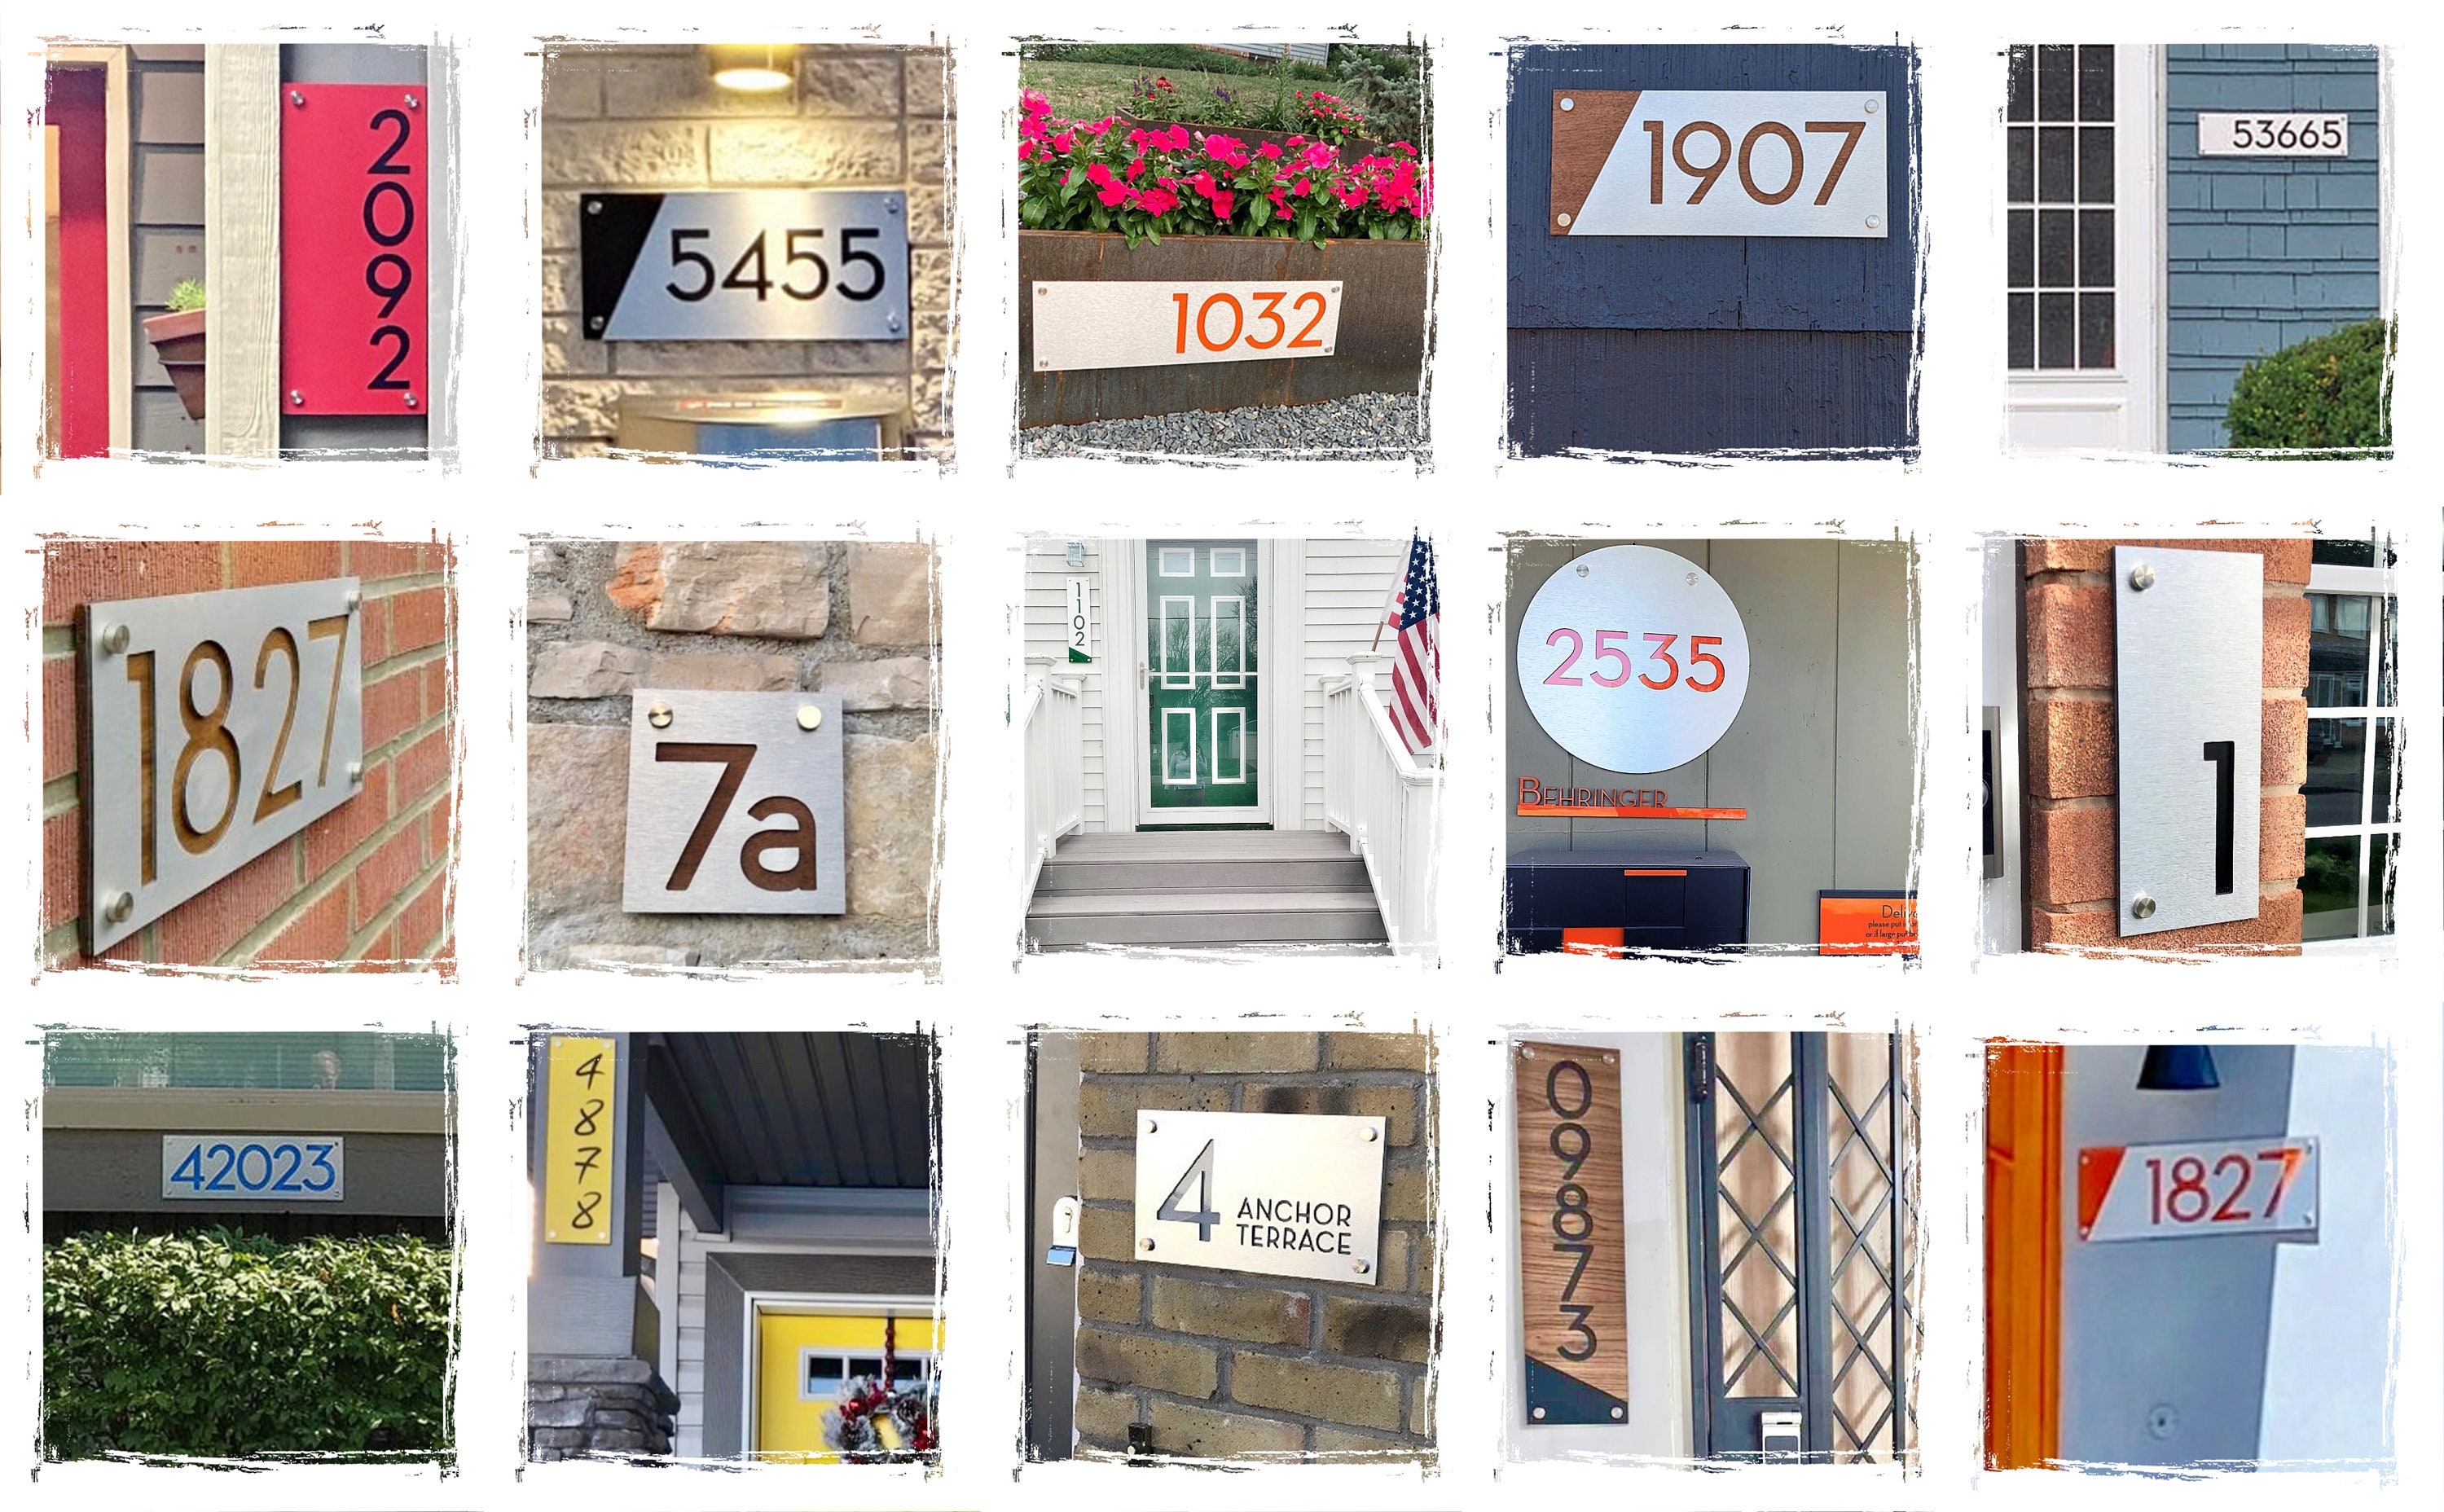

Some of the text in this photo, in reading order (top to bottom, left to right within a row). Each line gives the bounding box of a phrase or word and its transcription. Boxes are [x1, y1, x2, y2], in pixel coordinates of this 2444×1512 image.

[1642, 121, 1866, 206] 1907
[2232, 120, 2342, 149] 53665
[363, 109, 414, 390] 2092
[666, 228, 886, 301] 5455
[1172, 291, 1327, 354] 1032
[1073, 582, 1085, 646] 1102
[1543, 627, 1725, 692] 2535
[127, 613, 349, 888] 1827
[655, 742, 818, 892] 7a
[2203, 741, 2235, 895] 1
[170, 1144, 336, 1192] 42023
[571, 1053, 605, 1229] 4878
[1157, 1138, 1221, 1242] 4
[1237, 1196, 1352, 1227] ANCHOR
[1545, 1060, 1597, 1361] 09873
[2146, 1147, 2306, 1225] 1827
[1235, 1224, 1352, 1255] TERRACE
